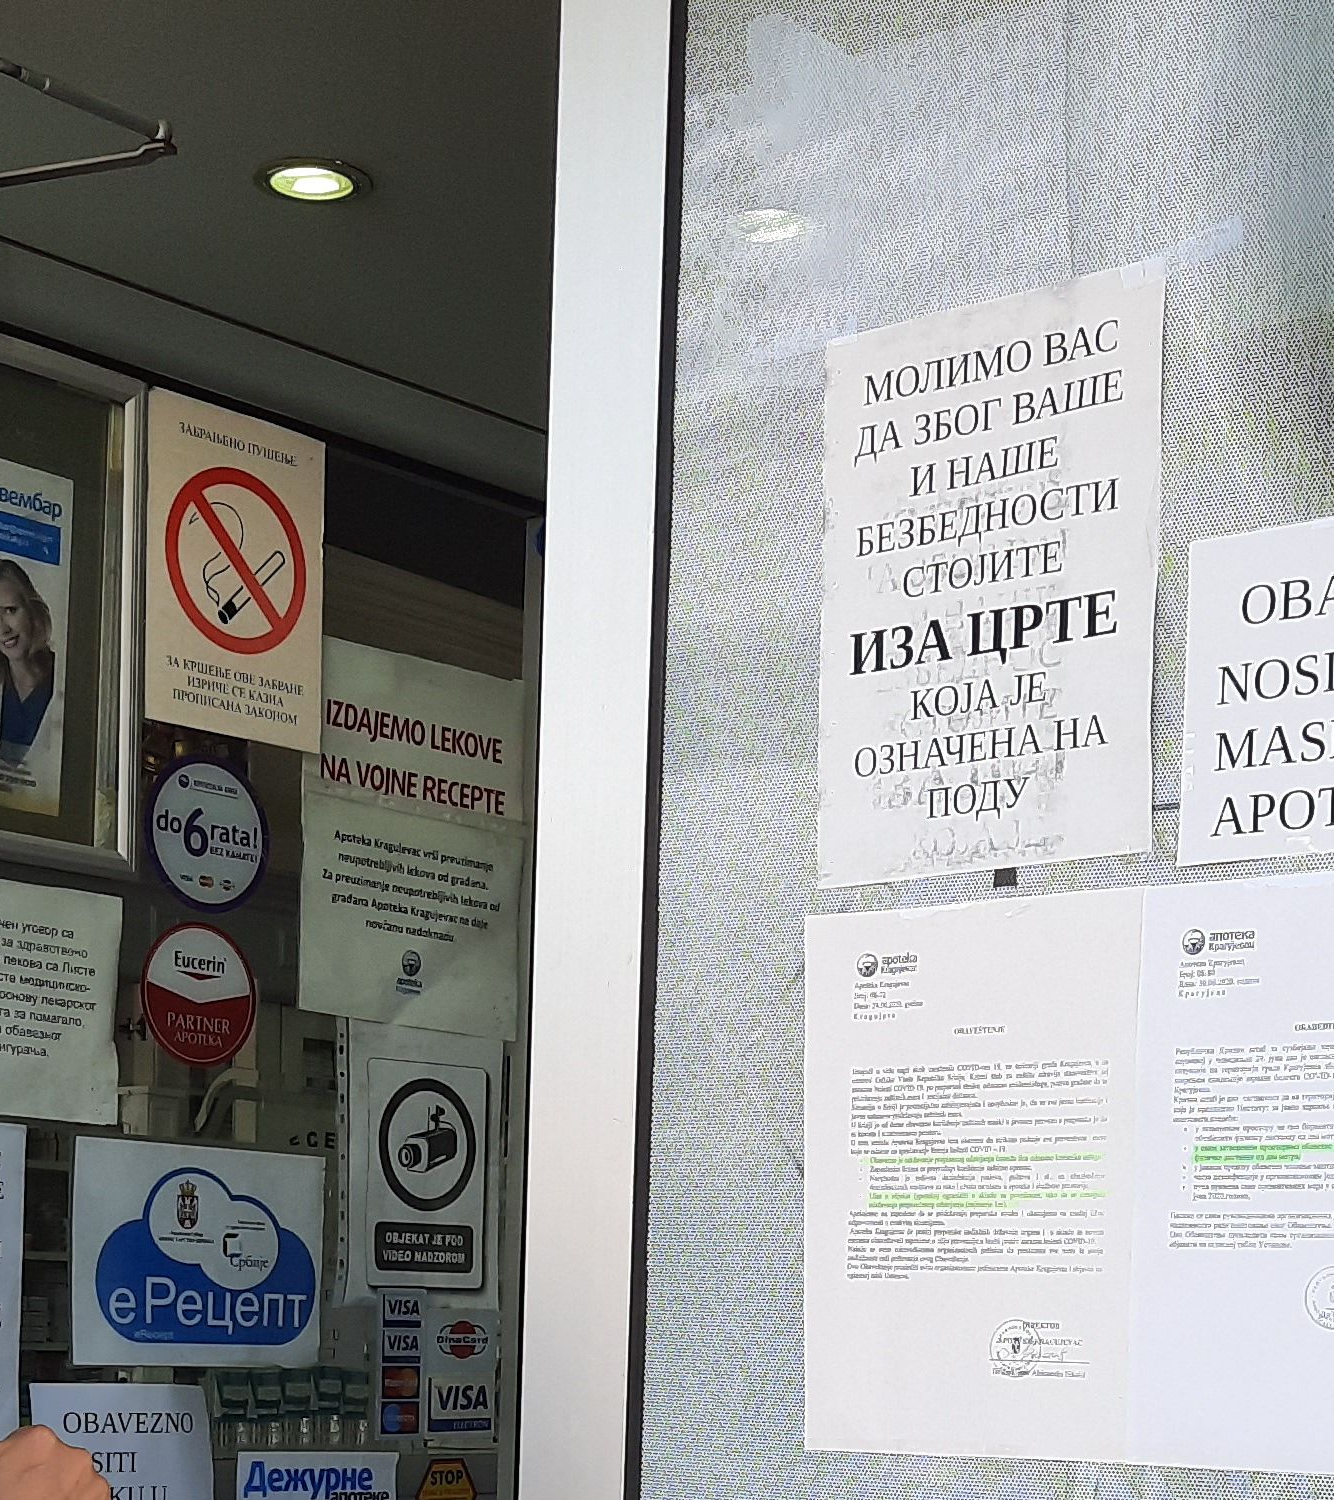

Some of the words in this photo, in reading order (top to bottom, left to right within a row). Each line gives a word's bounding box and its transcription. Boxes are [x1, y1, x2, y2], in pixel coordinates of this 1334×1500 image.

[862, 339, 1033, 409] МОЛИМО
[1042, 318, 1122, 367] ВАС
[853, 418, 904, 469] ДА
[913, 398, 1005, 447] ЗБОГ
[1012, 369, 1125, 427] ВАШЕ
[247, 442, 298, 468] ПУШЕЊЕ
[909, 465, 938, 499] И
[946, 437, 1060, 493] НАШЕ
[856, 477, 1122, 560] БЕЗБЕДНОСТИ
[902, 542, 1065, 602] СТОЈИТЕ
[847, 618, 955, 678] ИЗА
[966, 589, 1120, 667] ЦРТЕ
[183, 658, 232, 681] КРШЕЊЕ
[233, 671, 255, 686] ОВЕ
[258, 676, 304, 697] ЗАБРАНЕ
[187, 675, 229, 696] ИЗРИЧЕ
[231, 684, 247, 698] СЕ
[249, 688, 284, 708] КАЗНА
[909, 680, 1000, 723] КОЈА
[1004, 672, 1048, 711] ЈЕ
[173, 688, 242, 714] ПРОПИСАНА
[245, 704, 297, 726] ЗАКОНОМ
[326, 699, 426, 746] IZDAJEMO
[431, 724, 503, 764] LEKOVE
[853, 725, 1049, 780] ОЗНАЧЕНА
[1054, 714, 1109, 752] НА
[321, 753, 352, 785] NA
[356, 760, 418, 798] VOJNE
[423, 775, 505, 816] RECEPTE
[926, 776, 1032, 823] ПОДУ
[156, 809, 182, 834] do
[184, 808, 209, 857] 6
[211, 824, 258, 849] rata!
[334, 830, 371, 847] Apoteka
[322, 868, 333, 880] Za
[335, 871, 390, 892] preuzimanje
[490, 902, 501, 912] od
[438, 873, 449, 883] od
[371, 898, 408, 915] Apoteka
[459, 916, 469, 926] ne
[1, 936, 13, 947] за
[22, 922, 59, 939] уговор
[62, 929, 74, 939] са
[1209, 931, 1255, 942] апотека
[4, 955, 42, 970] лекова
[46, 962, 59, 972] са
[174, 951, 225, 974] Eucerin
[14, 1010, 26, 1020] за
[167, 1012, 230, 1034] PARTNER
[385, 1232, 430, 1245] OBJEKAT
[432, 1234, 443, 1245] JE
[445, 1235, 464, 1247] POD
[383, 1250, 412, 1262] VIDEO
[414, 1251, 465, 1264] NADZOROM
[388, 1299, 420, 1315] VISA
[387, 1335, 419, 1351] VISA
[437, 1335, 489, 1345] DinaCard
[436, 1385, 488, 1411] VISA
[63, 1412, 194, 1434] OBAVEZNO
[92, 1452, 137, 1473] SITI
[244, 1460, 374, 1500] Дежурне
[430, 1470, 464, 1486] STOP
